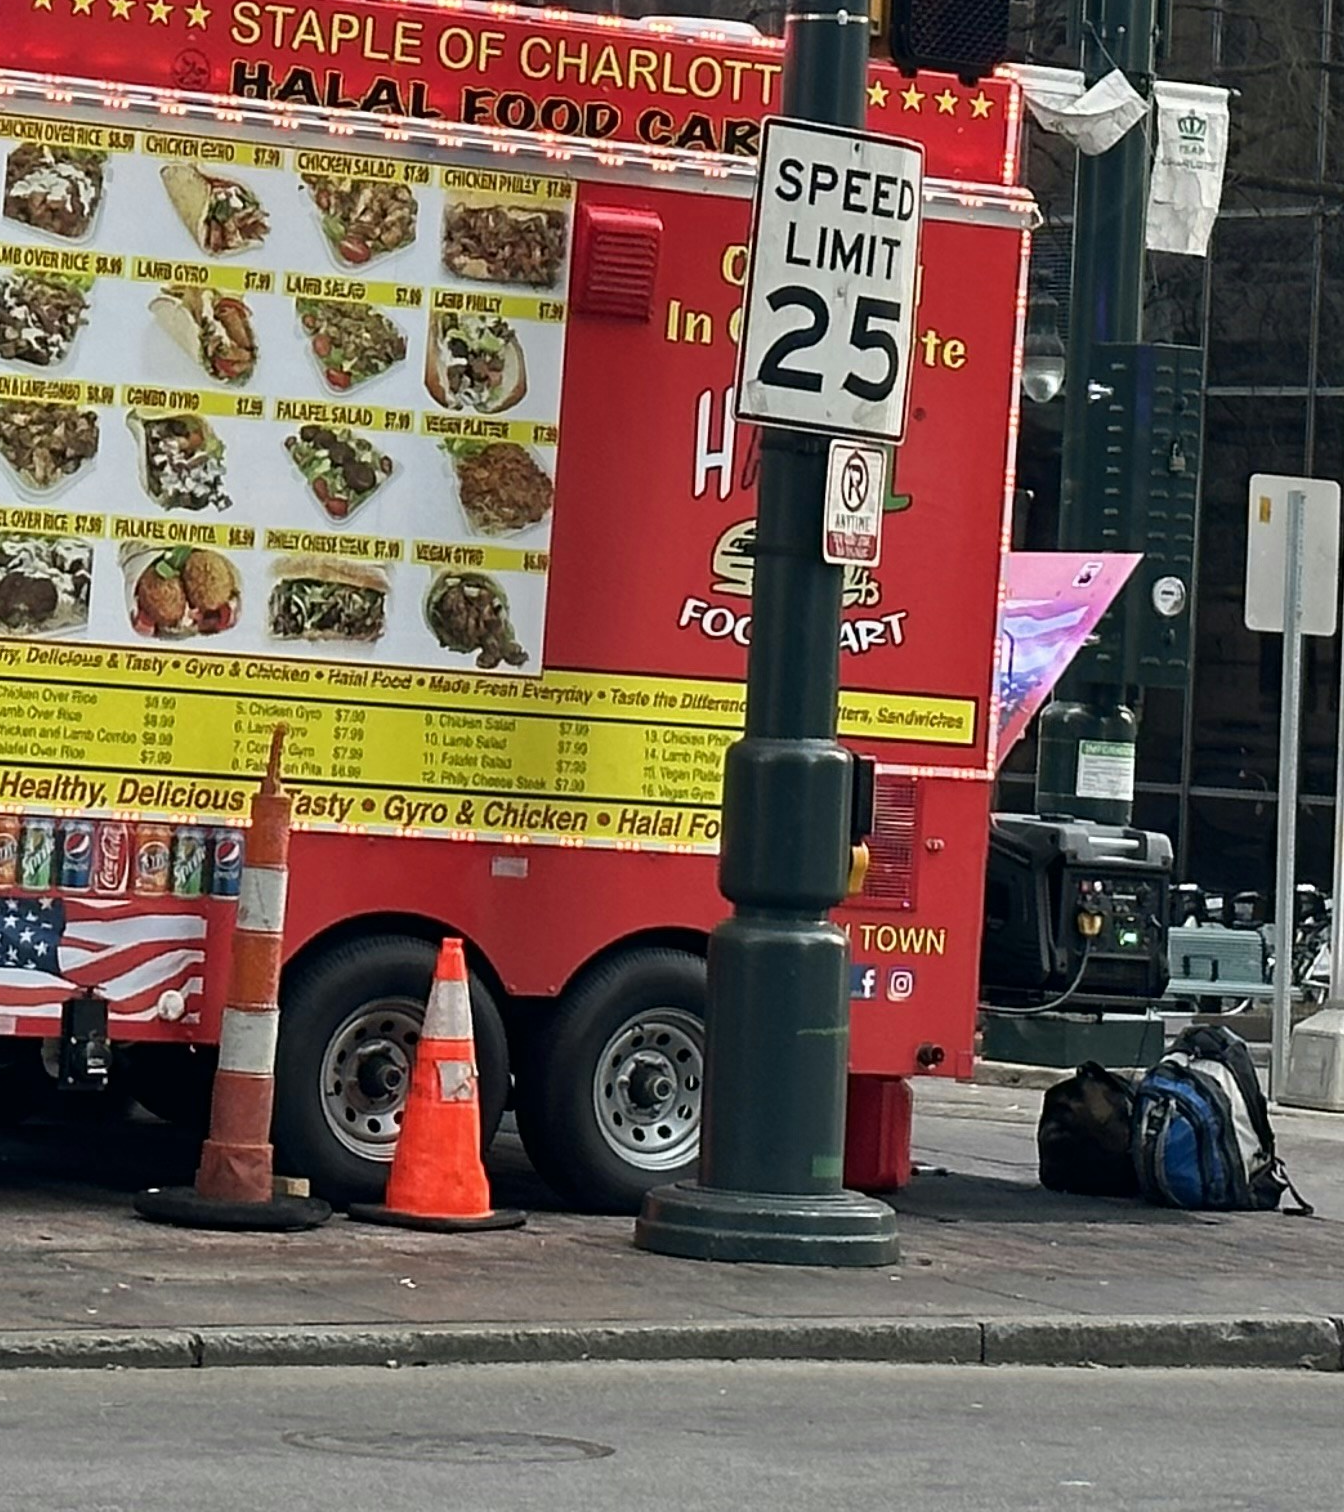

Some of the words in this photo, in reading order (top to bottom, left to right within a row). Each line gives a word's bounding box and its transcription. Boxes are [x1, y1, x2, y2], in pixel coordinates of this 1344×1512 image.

[230, 0, 424, 65] STAPLE
[438, 26, 506, 73] OF
[519, 36, 784, 106] CHARLOTT
[230, 58, 444, 120] HALAL
[460, 86, 623, 140] FOOD
[635, 107, 762, 157] CAR
[45, 124, 76, 143] OVER
[77, 127, 104, 147] RICE
[146, 135, 199, 158] CHICKEN
[298, 152, 351, 174] CHICKEN
[354, 157, 396, 179] SALAD
[444, 169, 498, 191] CHICKEN
[774, 158, 916, 223] SPEED
[24, 249, 59, 268] OVER
[61, 252, 90, 272] RICE
[785, 222, 902, 281] LIMIT
[666, 299, 714, 346] In
[756, 284, 903, 403] 25
[331, 406, 373, 426] SALAD
[678, 596, 753, 648] FOO
[838, 609, 908, 654] ART
[125, 654, 169, 676] Tasty
[184, 657, 225, 679] Gyro
[244, 661, 310, 683] Chicken
[610, 687, 650, 707] Taste
[653, 691, 677, 709] the
[679, 692, 747, 713] Differenc
[876, 706, 964, 731] Sandwiches
[117, 778, 245, 814] Delicious
[285, 787, 355, 820] Tasty
[383, 794, 448, 825] Gyro
[455, 799, 474, 826] &
[483, 802, 588, 833] Chicken
[616, 808, 684, 837] Halal
[687, 812, 722, 839] Fo
[860, 925, 946, 955] TOWN
